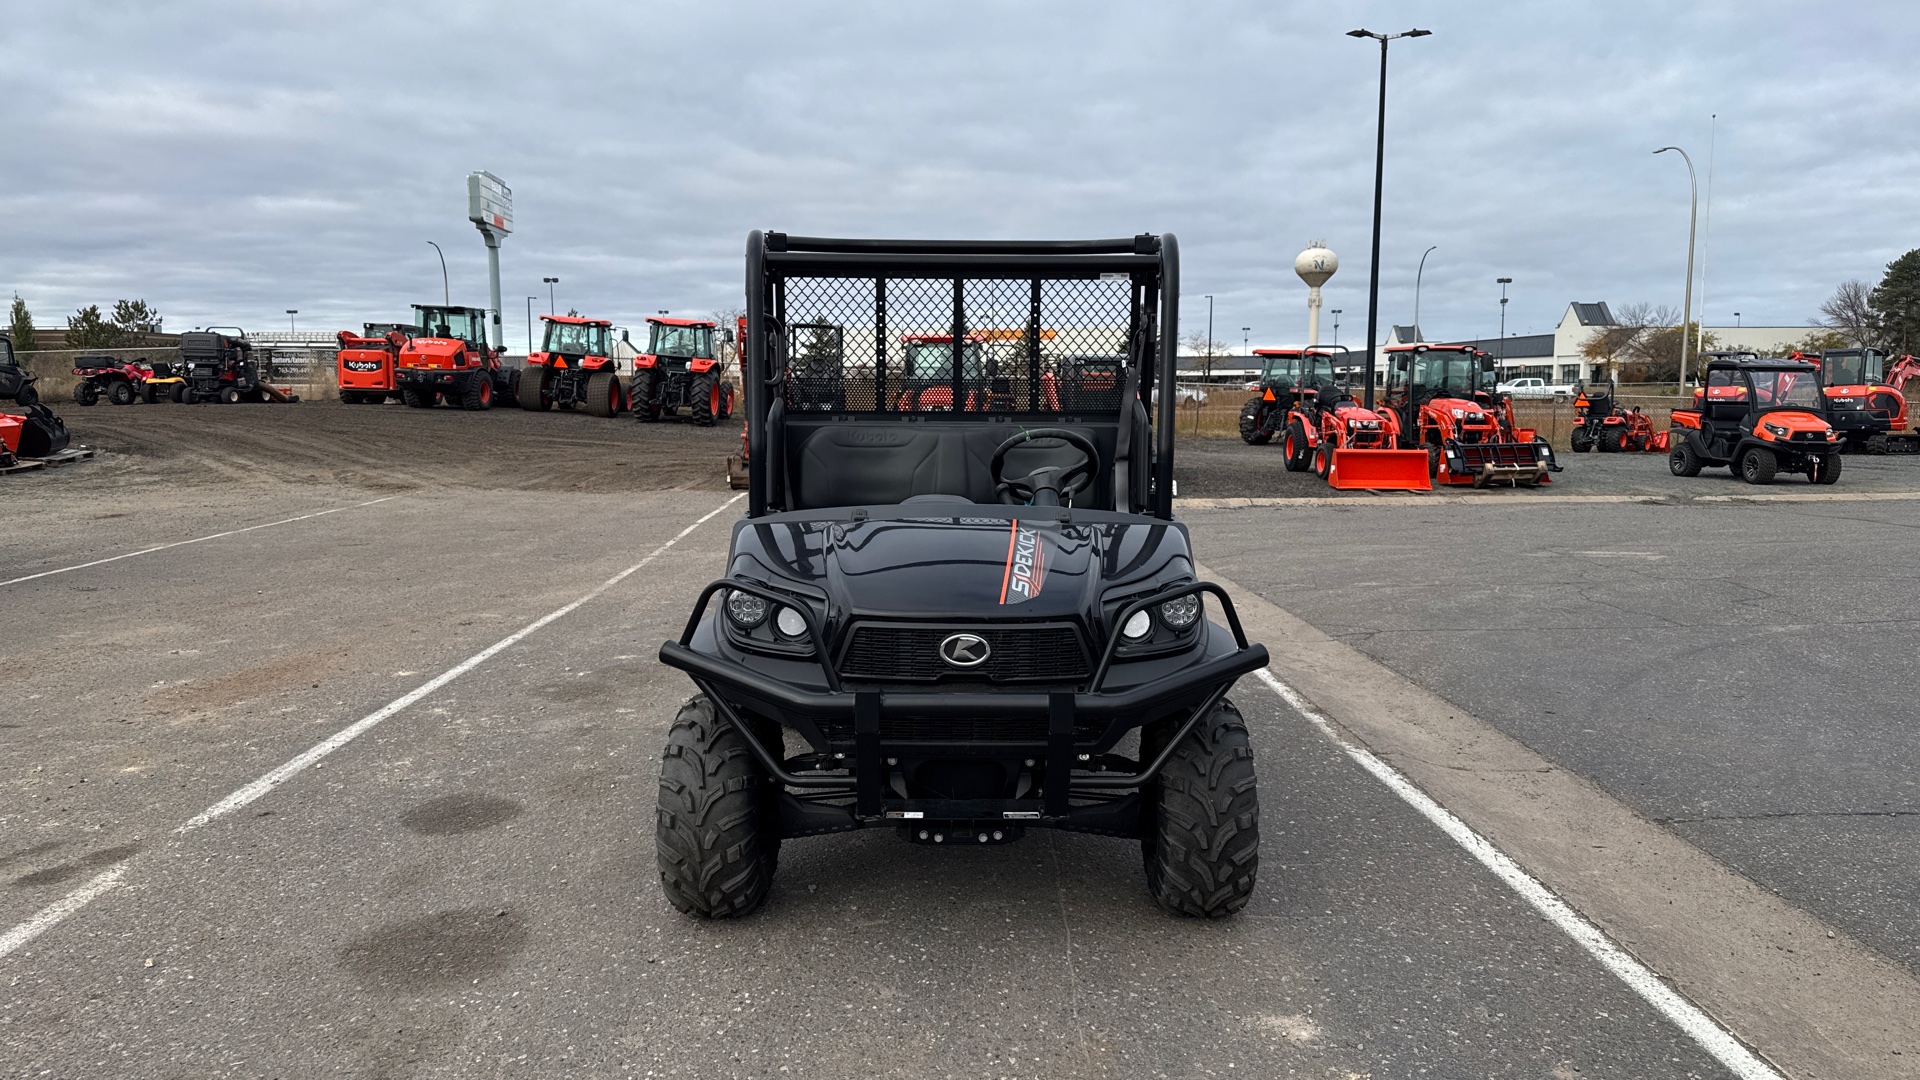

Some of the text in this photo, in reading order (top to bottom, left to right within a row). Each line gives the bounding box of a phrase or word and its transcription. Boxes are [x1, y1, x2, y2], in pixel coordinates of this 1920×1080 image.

[348, 361, 377, 370] Kubota
[847, 430, 897, 442] Kubota
[1012, 527, 1037, 597] SIDEKICK
